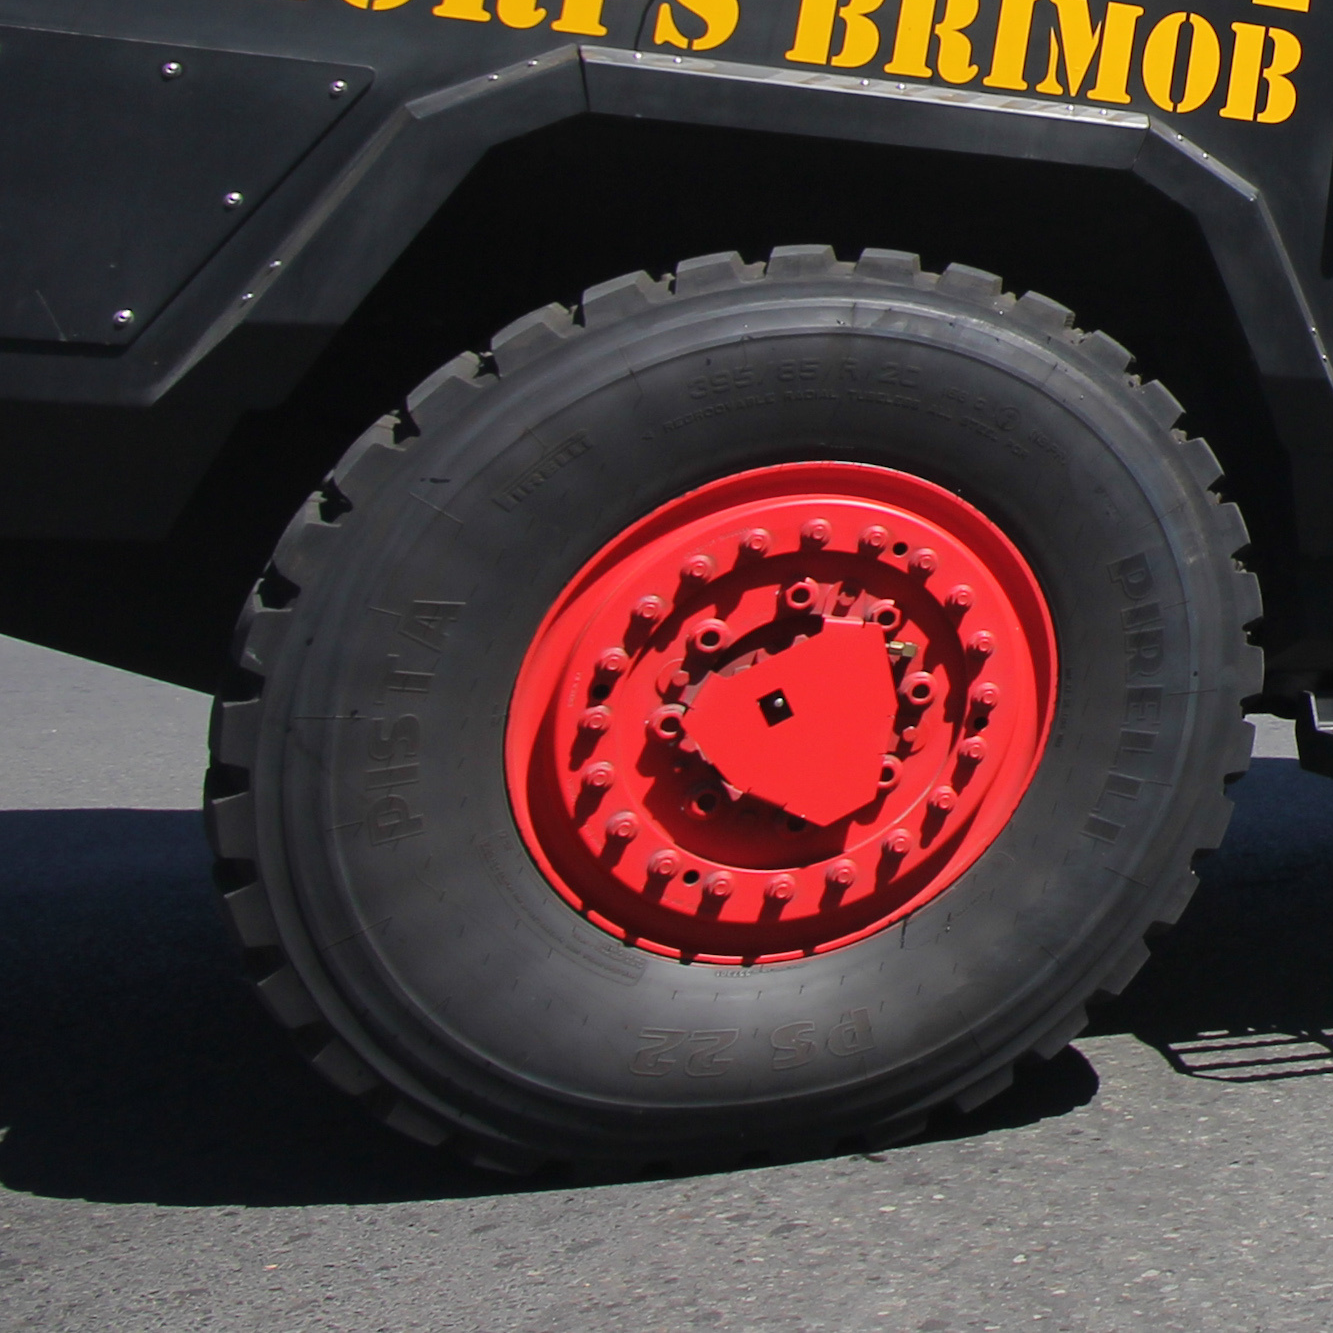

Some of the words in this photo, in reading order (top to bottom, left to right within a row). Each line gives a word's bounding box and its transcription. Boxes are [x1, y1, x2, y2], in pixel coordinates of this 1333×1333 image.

[361, 599, 466, 847] PISTA
[1085, 555, 1169, 850] PIRELLI
[628, 1025, 740, 1077] 22
